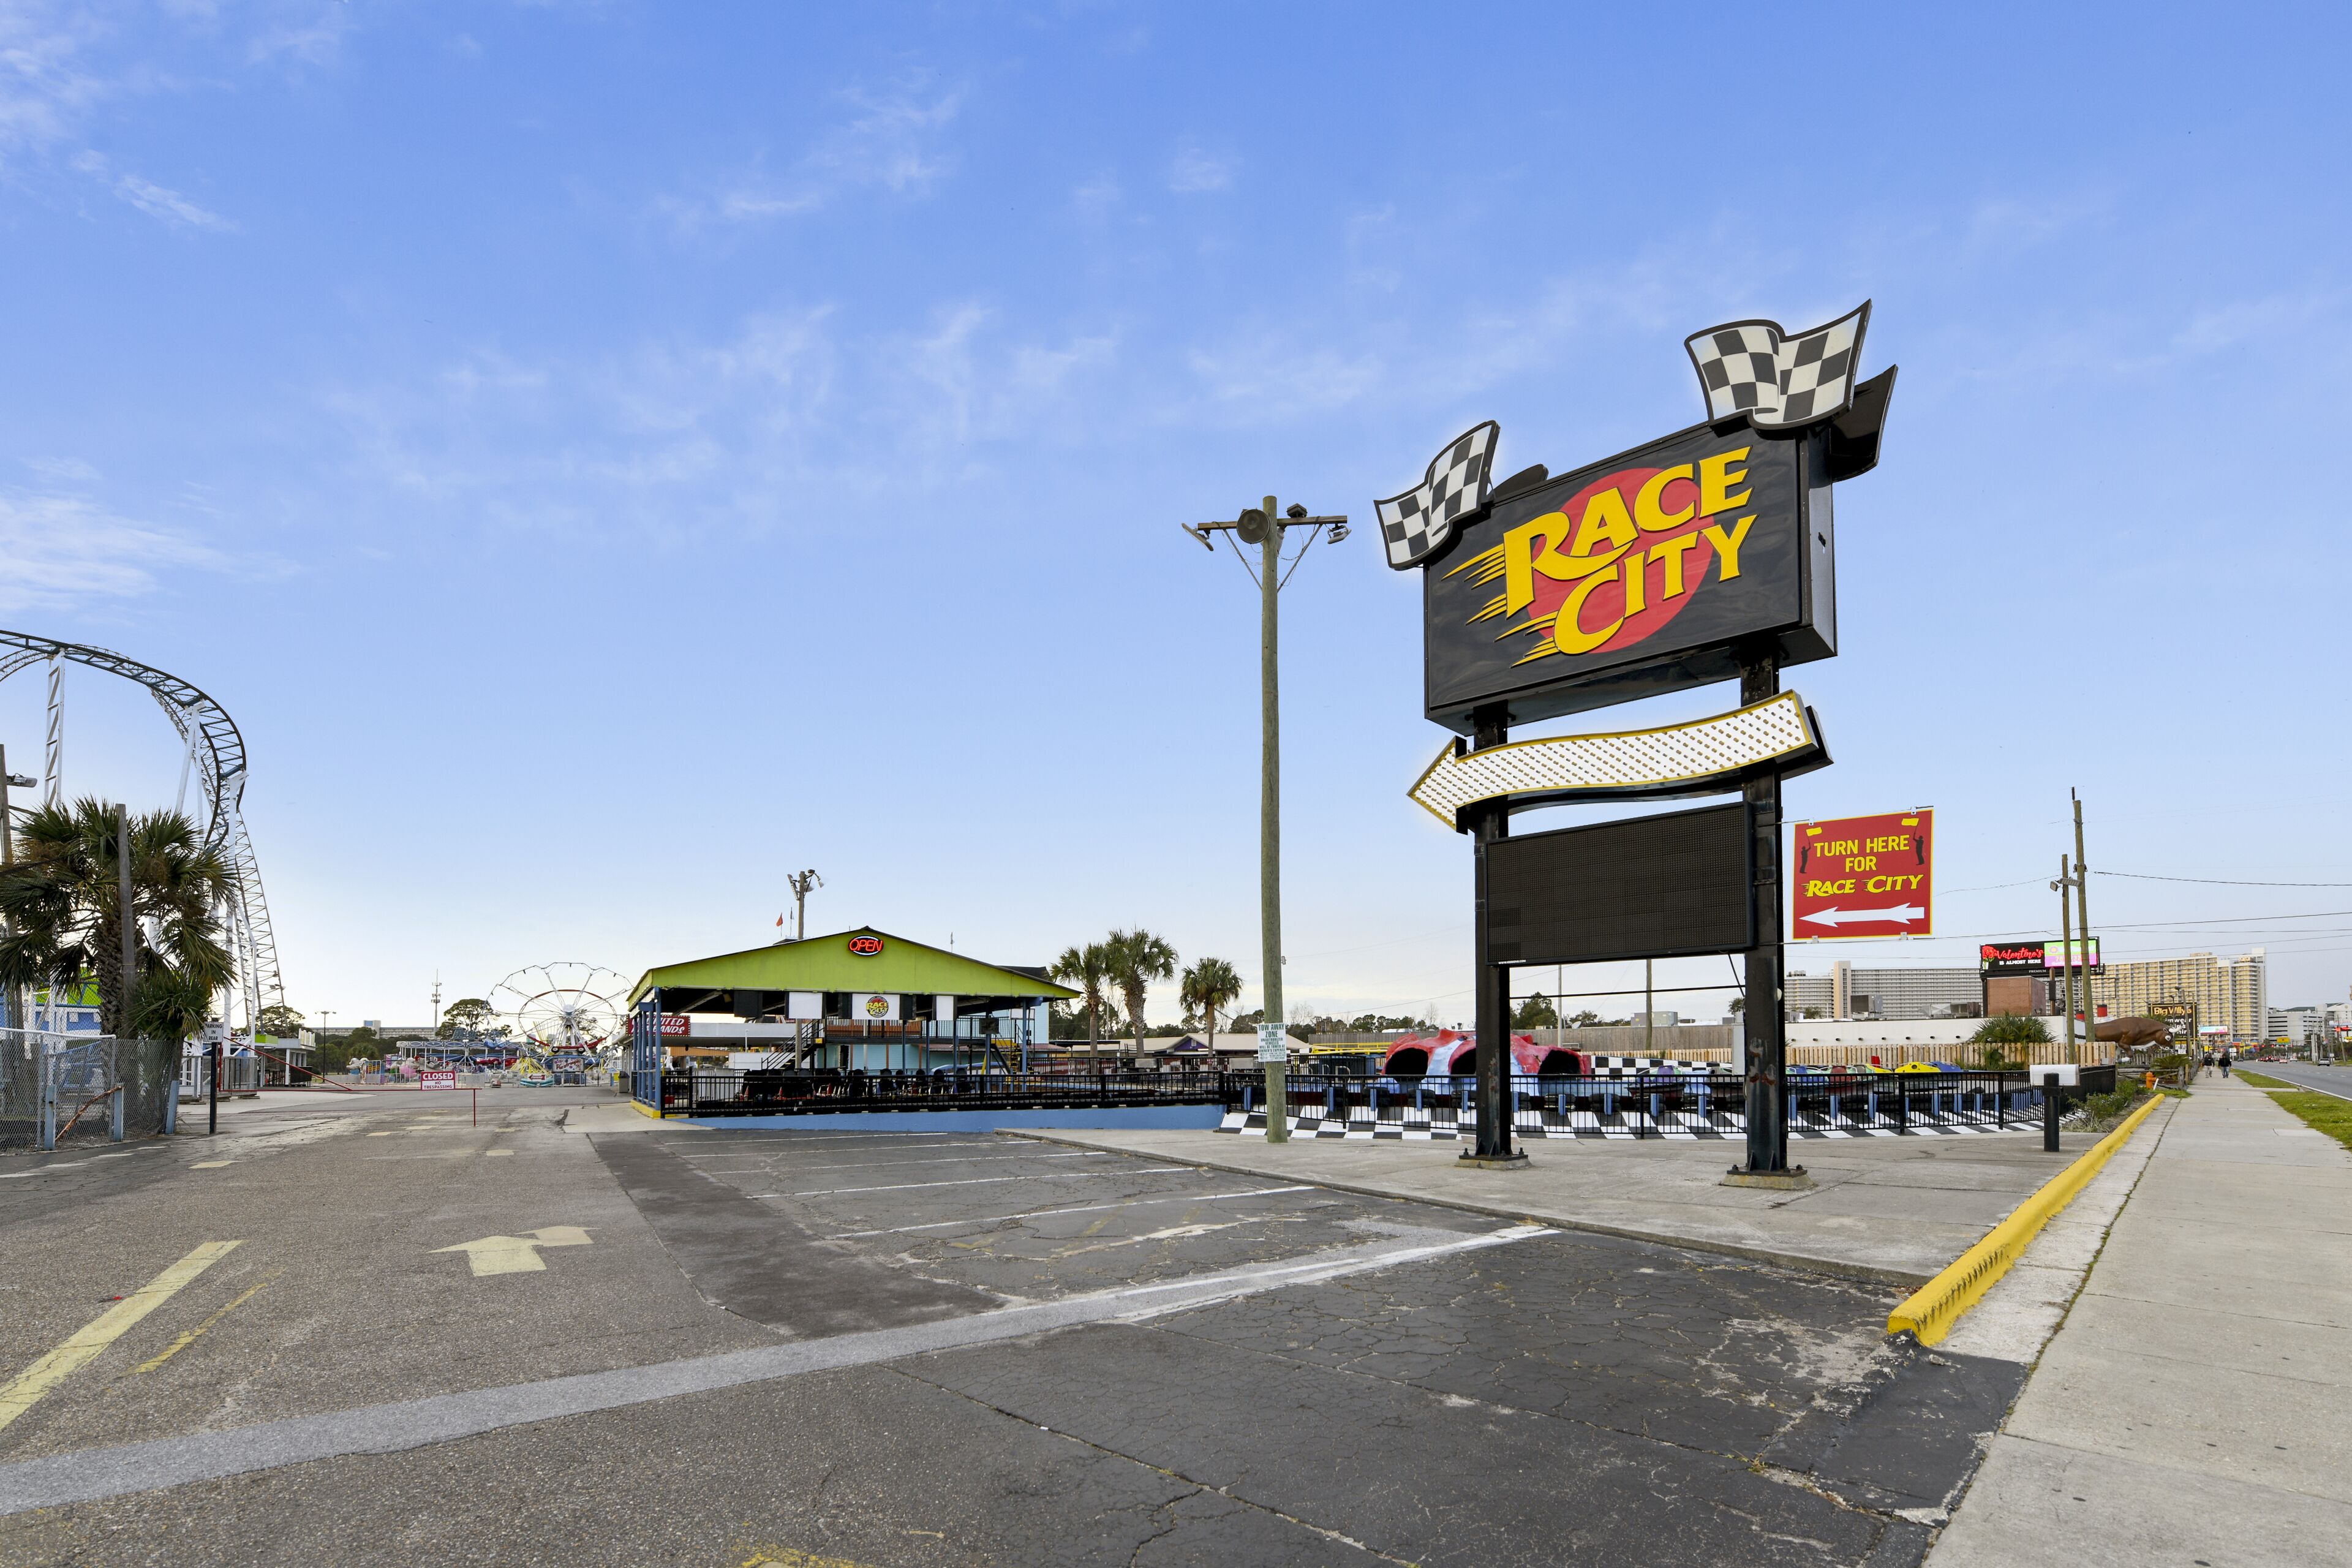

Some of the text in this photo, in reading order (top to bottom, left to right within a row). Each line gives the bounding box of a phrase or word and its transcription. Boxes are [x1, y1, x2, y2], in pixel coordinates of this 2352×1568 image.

[1503, 445, 1753, 620] RACE
[1554, 513, 1759, 655] CITY
[1814, 834, 1910, 858] TURN HERE
[1845, 856, 1877, 873] FOR
[1806, 874, 1924, 897] RACE CITY
[850, 939, 883, 951] OPEN
[1997, 947, 2044, 960] Valentine's
[865, 1001, 889, 1011] RACE
[2154, 1007, 2168, 1016] Big
